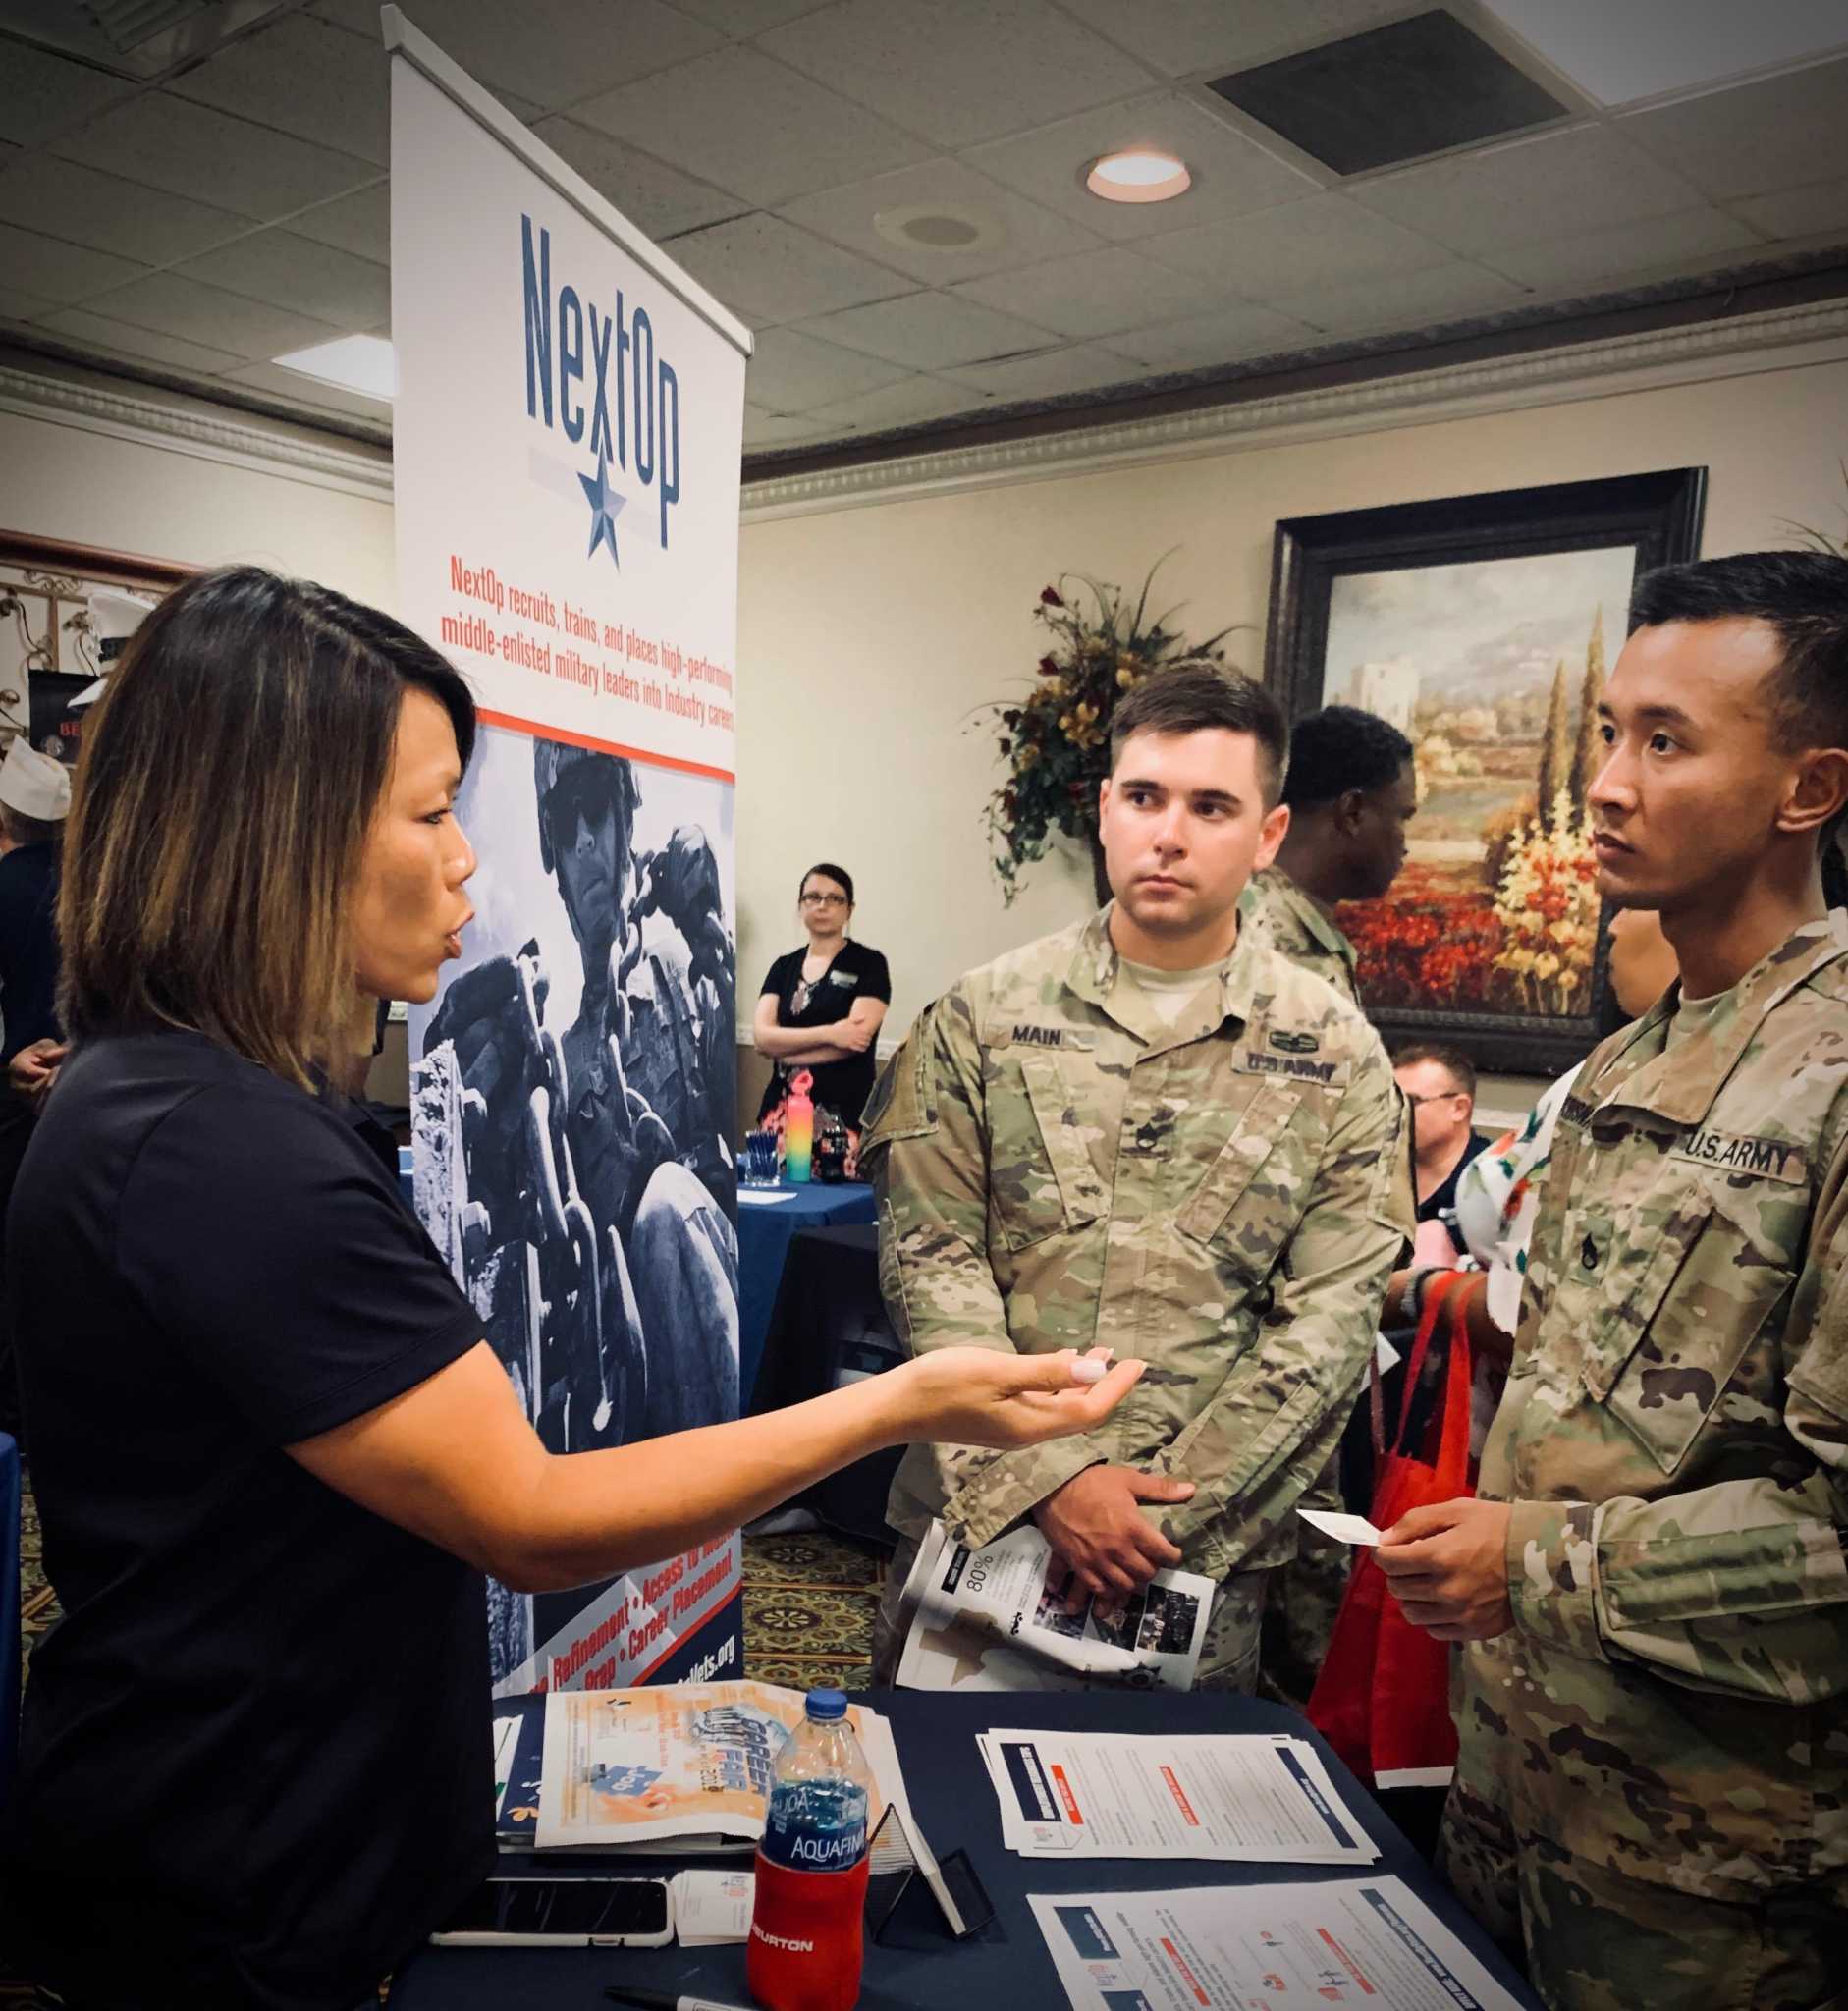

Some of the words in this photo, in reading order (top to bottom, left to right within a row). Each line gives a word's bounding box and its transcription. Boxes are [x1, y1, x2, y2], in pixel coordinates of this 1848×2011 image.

[520, 212, 679, 550] NextOp
[451, 555, 504, 615] NextOp
[509, 586, 560, 632] recruits,
[564, 600, 600, 649] trains,
[604, 624, 623, 652] and
[626, 628, 659, 666] places
[442, 611, 551, 675] middle-enlisted
[555, 648, 599, 696] military
[603, 662, 639, 702] leaders
[643, 677, 662, 709] into
[1012, 1025, 1061, 1046] MAIN
[966, 1555, 994, 1592] 80%
[628, 1604, 669, 1660] Career
